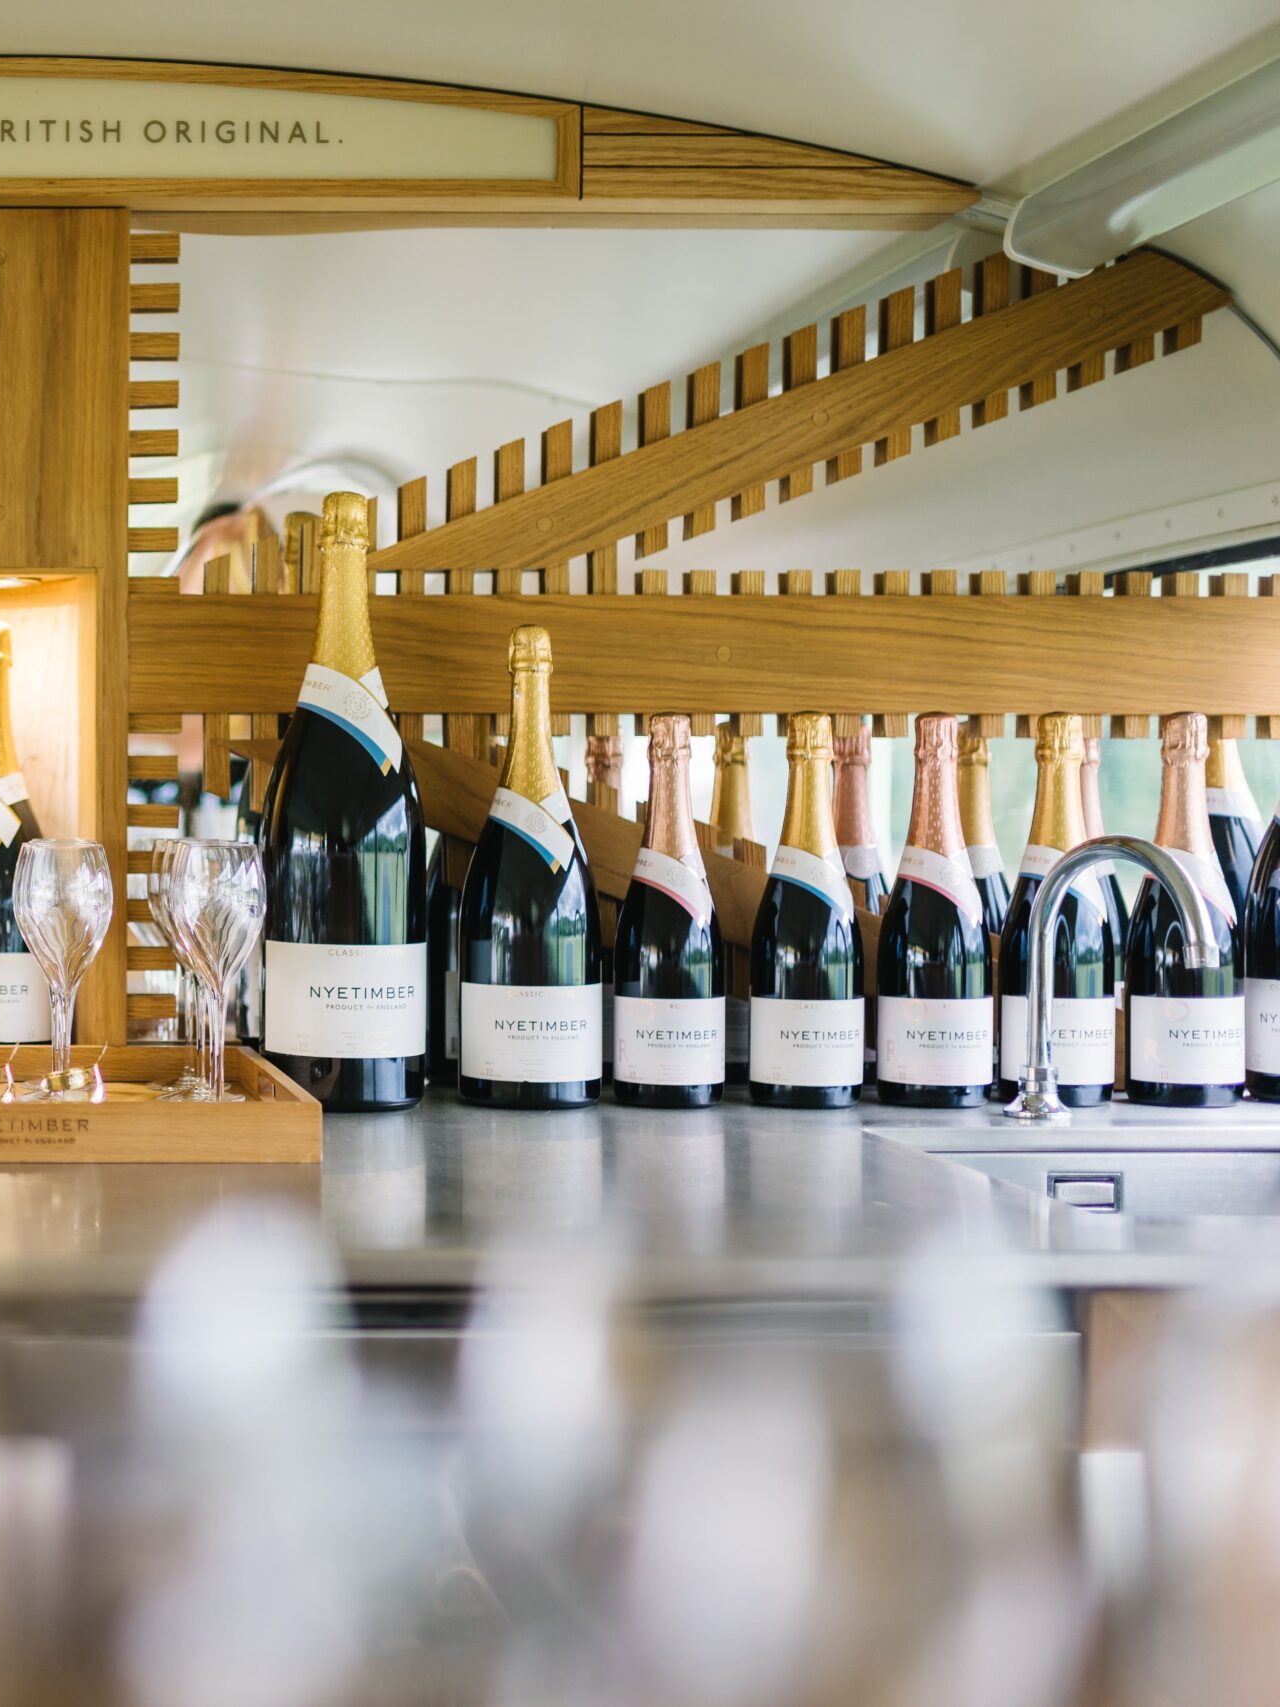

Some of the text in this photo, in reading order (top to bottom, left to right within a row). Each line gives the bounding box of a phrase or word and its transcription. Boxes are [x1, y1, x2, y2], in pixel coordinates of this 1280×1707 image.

[143, 119, 344, 143] ORIGINAL.
[309, 985, 416, 1000] NYETIMBER
[325, 1003, 364, 1011] PRODUCT
[376, 1003, 408, 1011] ENGLAND
[494, 1019, 587, 1032] NYETIMBER
[636, 1029, 718, 1041] NYETIMBER
[780, 1029, 860, 1041] NYETIMBER
[906, 1029, 989, 1041] NYETIMBER
